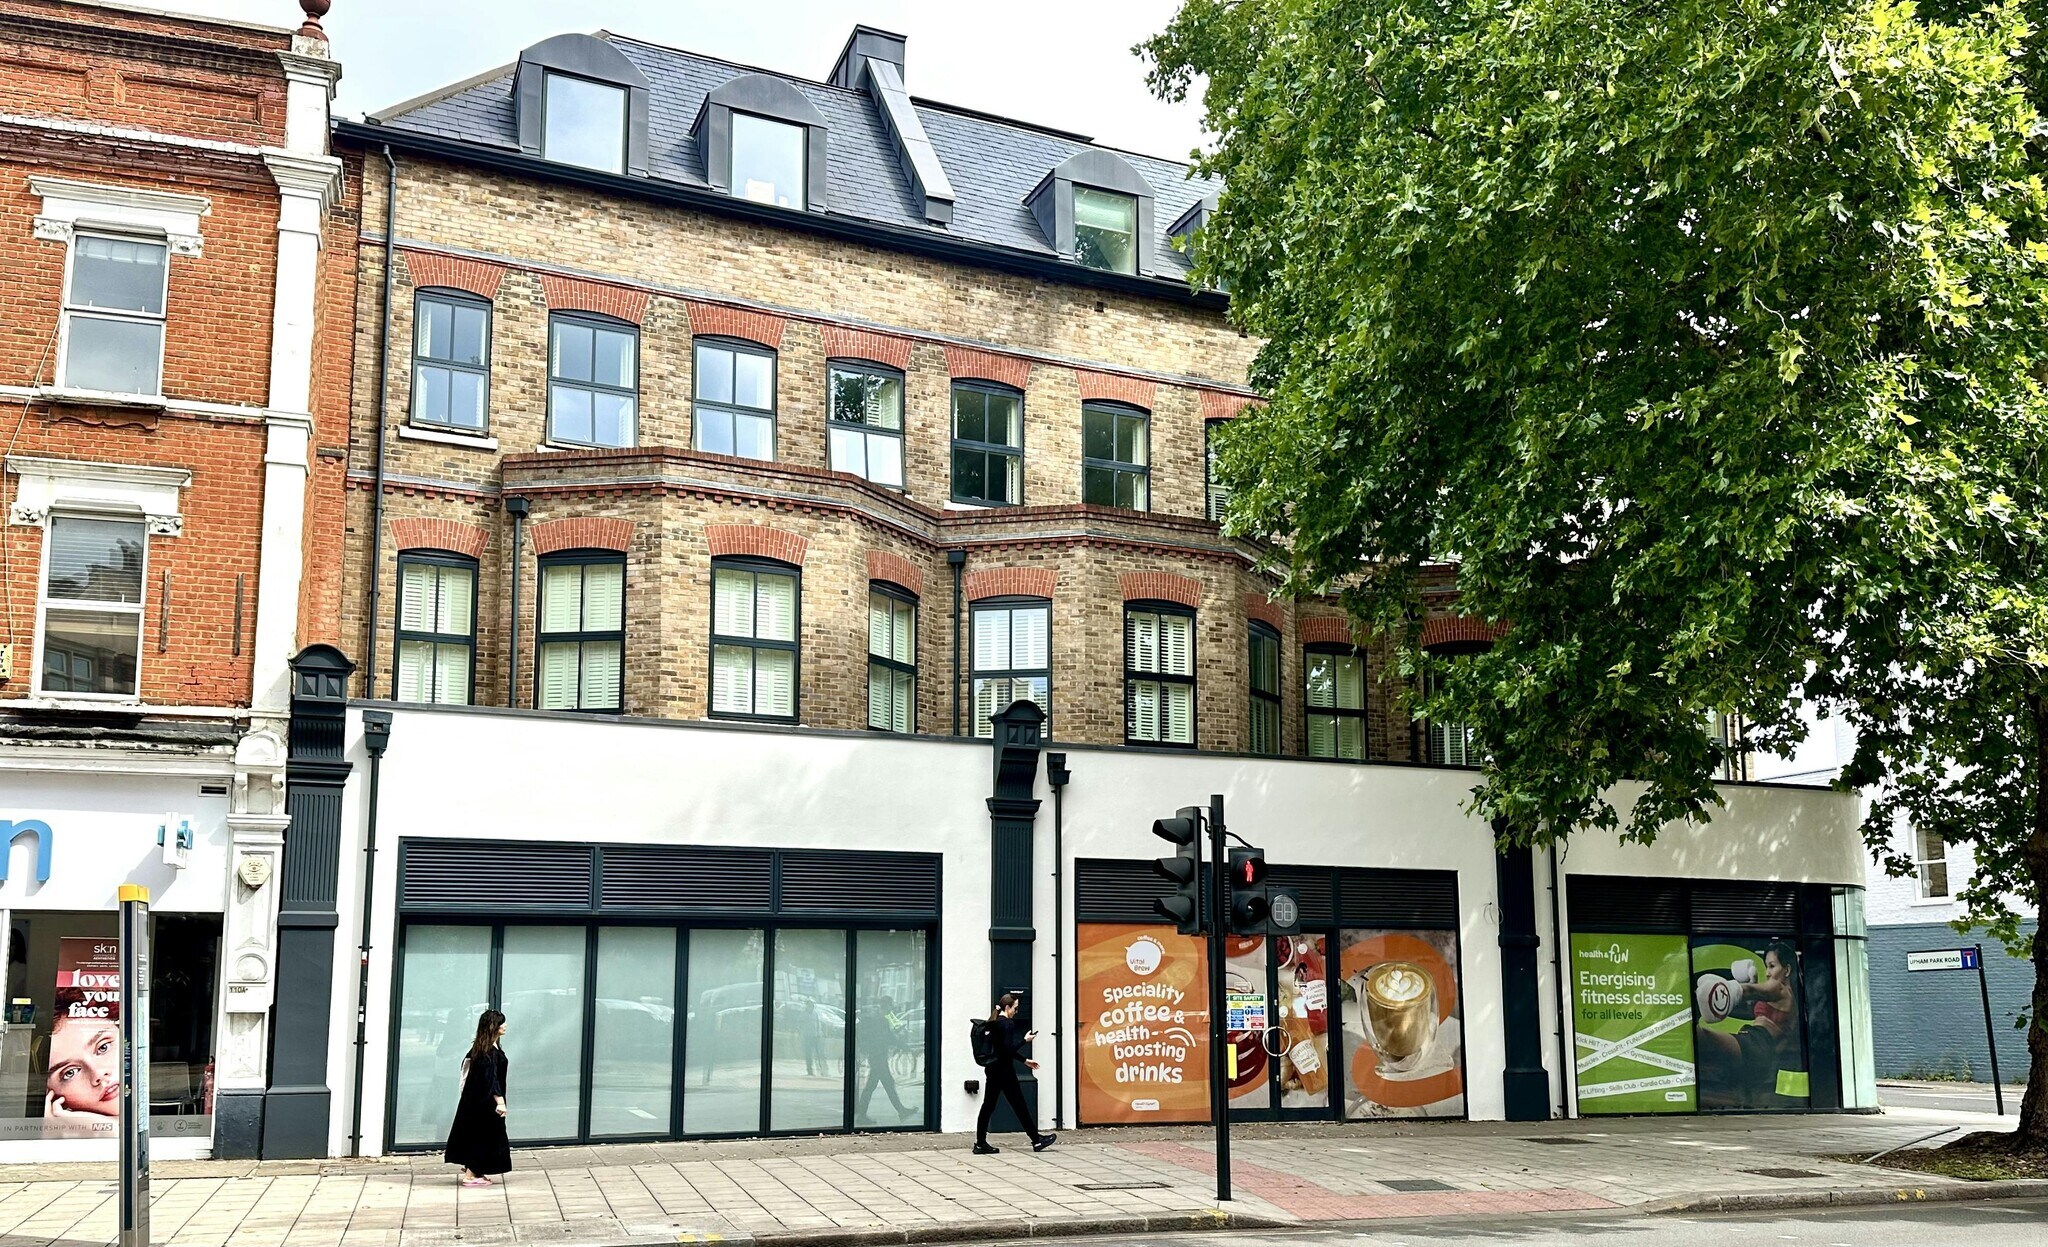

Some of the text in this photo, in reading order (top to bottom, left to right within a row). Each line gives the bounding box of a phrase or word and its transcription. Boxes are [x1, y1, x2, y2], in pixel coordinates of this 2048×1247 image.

[1579, 950, 1603, 958] health
[1580, 971, 1655, 989] Energising
[1581, 989, 1683, 1005] fitness classes
[68, 1002, 109, 1018] face
[1100, 1001, 1185, 1028] coffee &
[1582, 1009, 1642, 1019] for all levels
[1655, 1019, 1675, 1032] Training
[1114, 1041, 1186, 1062] boosting
[1630, 1050, 1693, 1073] Gymnastics Stretching
[1115, 1062, 1183, 1084] drinks
[92, 1123, 112, 1131] NHS
